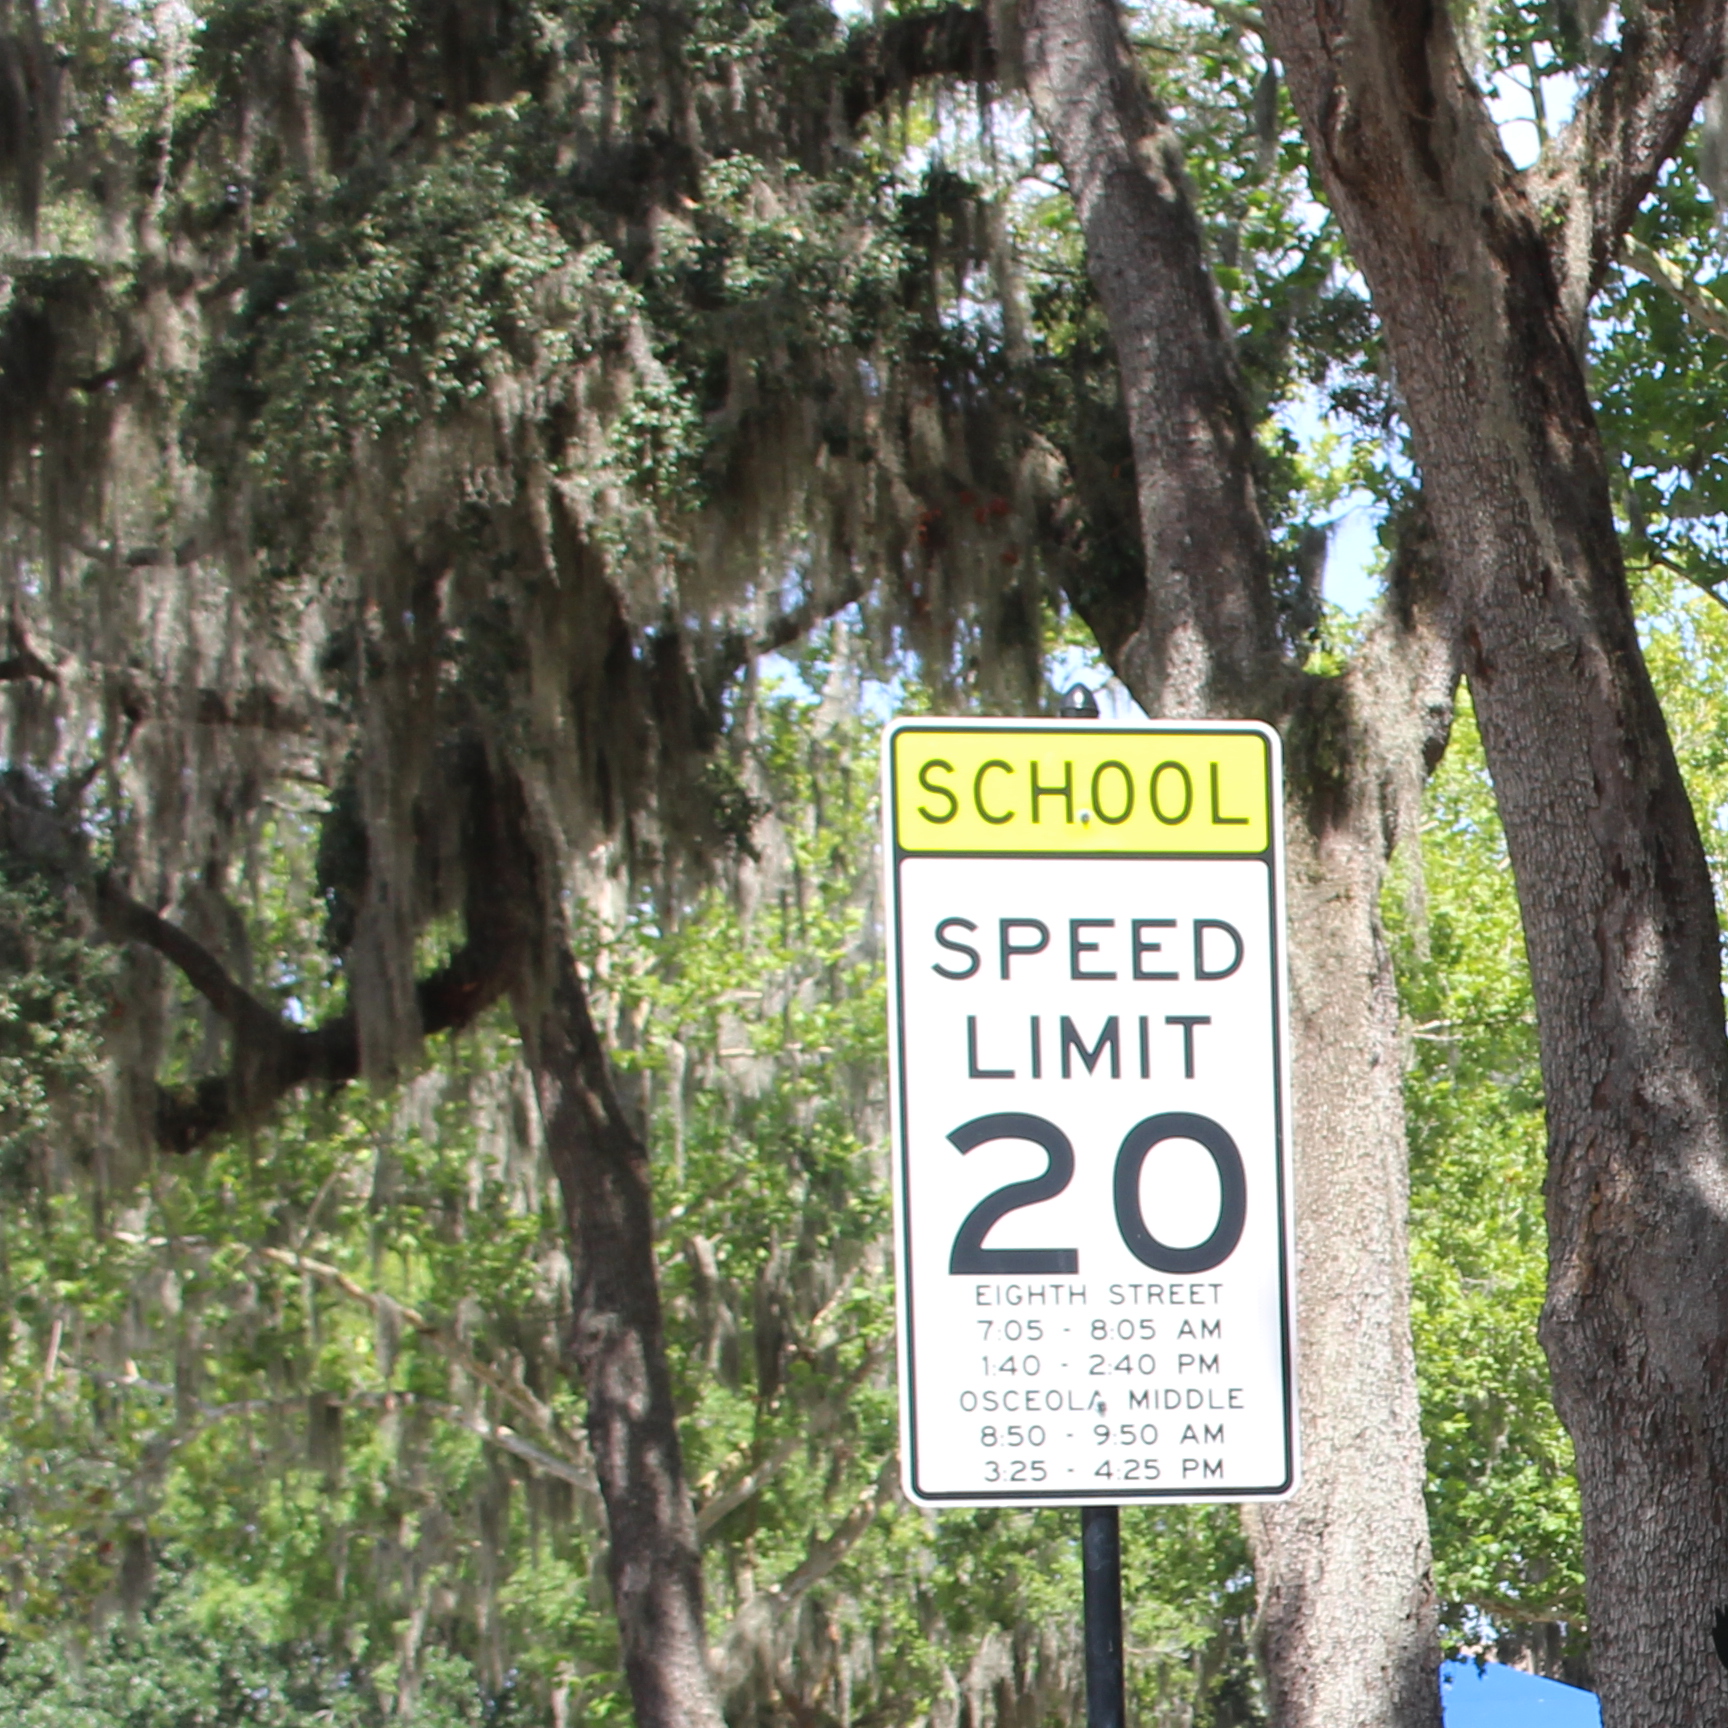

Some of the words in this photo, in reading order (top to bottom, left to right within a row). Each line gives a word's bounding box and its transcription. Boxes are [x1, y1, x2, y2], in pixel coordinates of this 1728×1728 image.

[917, 758, 1250, 826] SCHOOL
[930, 916, 1245, 981] SPEED
[966, 1014, 1212, 1080] LIMIT
[945, 1111, 1248, 1275] 20
[975, 1284, 1087, 1306] EIGHTH
[1108, 1283, 1224, 1305] STREET
[976, 1319, 1044, 1341] 7:05
[1090, 1318, 1156, 1341] 8:05
[1176, 1318, 1222, 1340] AM
[982, 1354, 1041, 1376] 1:40
[1088, 1353, 1156, 1376] 2:40
[1177, 1353, 1220, 1375] PM
[1128, 1388, 1245, 1410] MIDDLE
[980, 1425, 1046, 1447] 8:50
[1093, 1423, 1158, 1446] 9:50
[1179, 1423, 1225, 1444] AM
[984, 1459, 1047, 1482] 3:25
[1093, 1458, 1161, 1480] 4:25
[1182, 1458, 1224, 1479] PM
